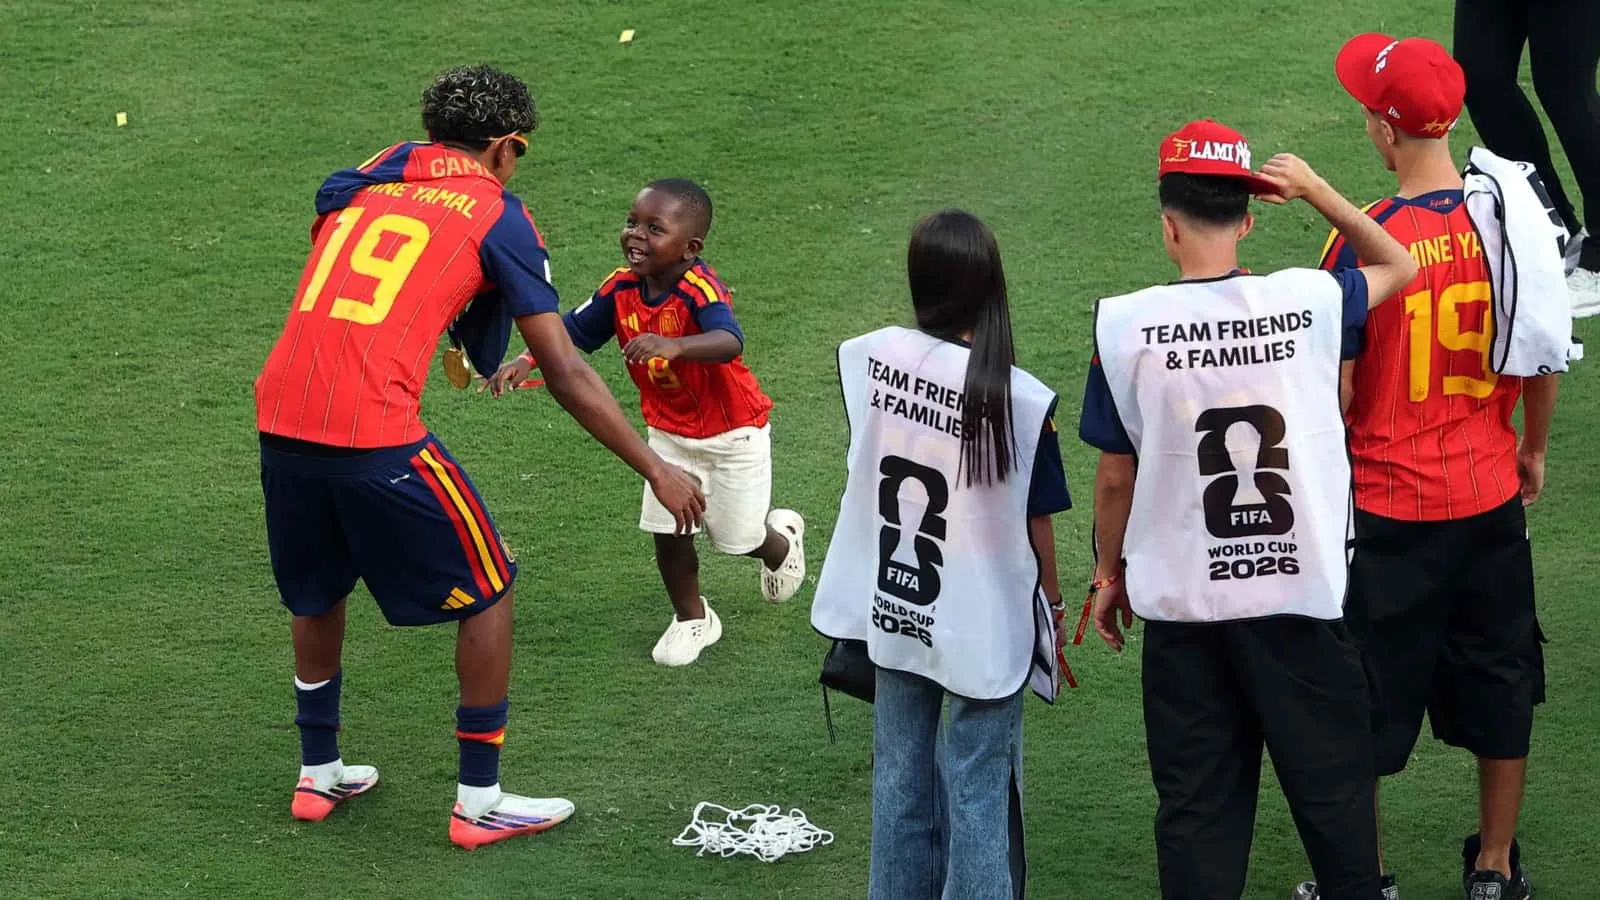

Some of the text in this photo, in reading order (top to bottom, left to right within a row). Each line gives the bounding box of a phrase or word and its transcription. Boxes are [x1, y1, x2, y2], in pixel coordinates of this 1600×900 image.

[412, 186, 478, 219] YAMAL
[299, 207, 431, 325] 19
[1142, 309, 1313, 345] TEAM FRIENDS
[1405, 281, 1499, 402] 19
[1165, 339, 1295, 370] & FAMILIES
[868, 356, 909, 392] TEAM
[884, 394, 964, 438] FAMILIE
[1230, 510, 1273, 526] FIFA
[1207, 541, 1298, 559] WORLD CUP
[886, 566, 920, 592] FIFA
[1208, 556, 1301, 581] 2026
[872, 605, 933, 648] 2026
[909, 610, 935, 628] CUP
